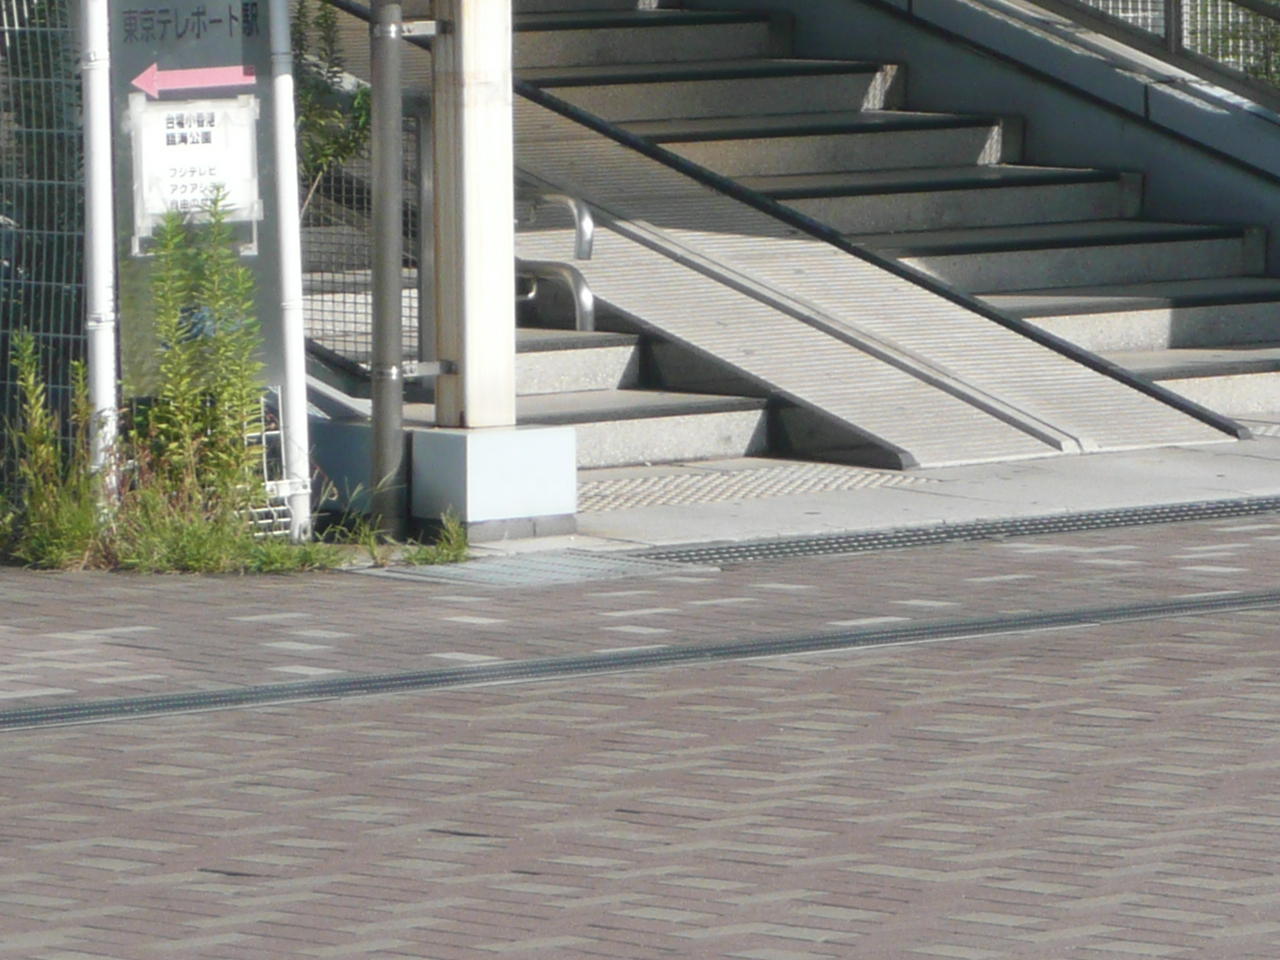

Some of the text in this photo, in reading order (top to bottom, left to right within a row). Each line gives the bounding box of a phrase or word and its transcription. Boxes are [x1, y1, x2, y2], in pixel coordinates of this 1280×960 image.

[122, 1, 260, 43] 東京テレポート駅
